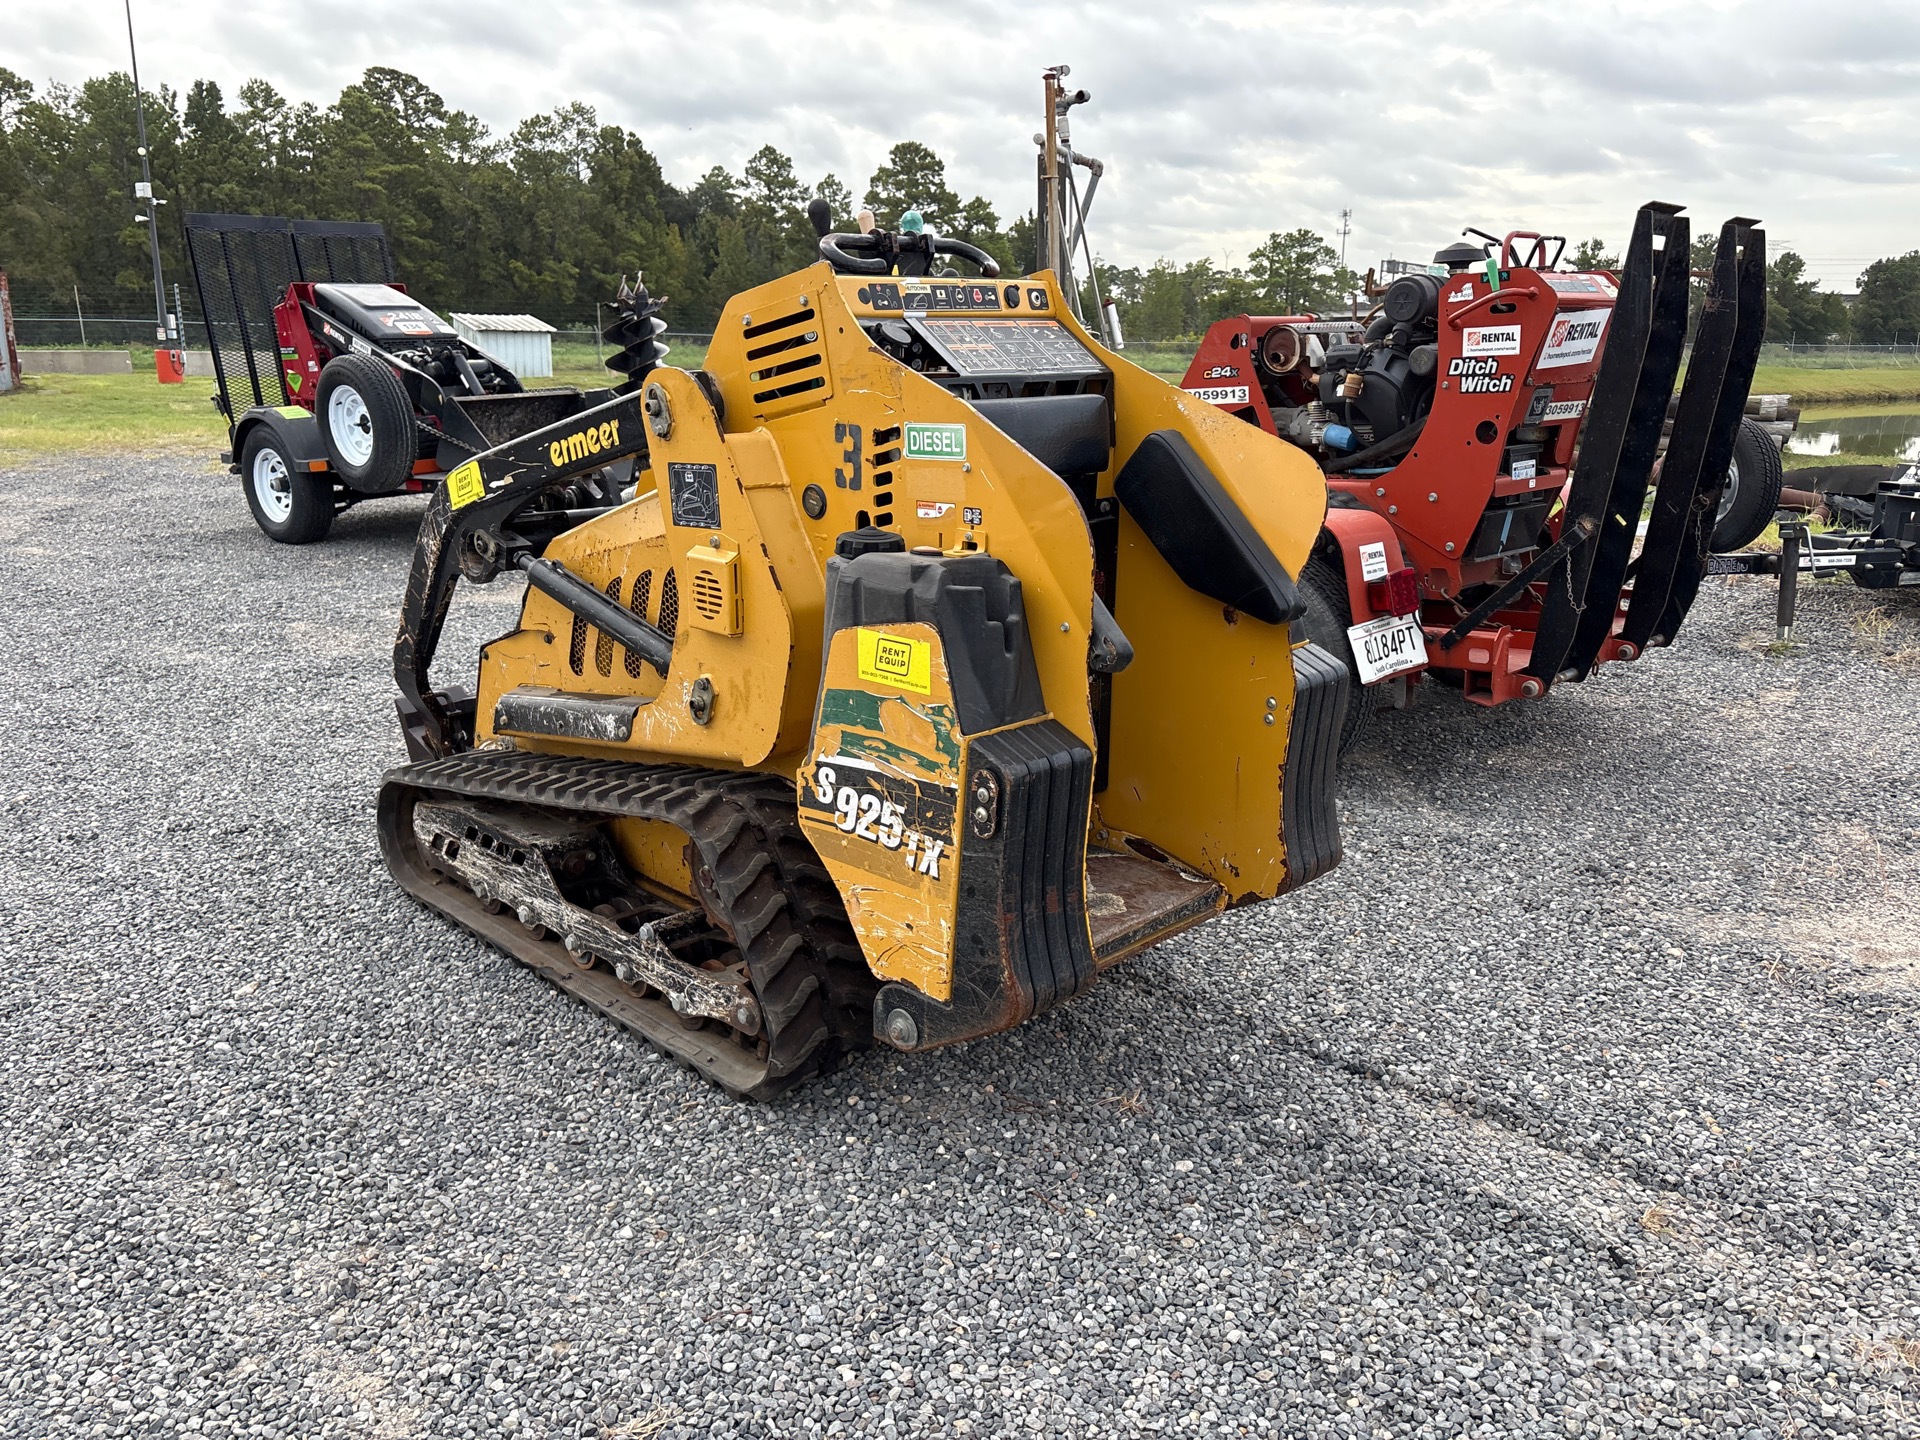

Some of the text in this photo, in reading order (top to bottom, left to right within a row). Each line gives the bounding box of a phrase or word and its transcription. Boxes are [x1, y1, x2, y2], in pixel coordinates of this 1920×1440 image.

[1481, 332, 1517, 343] RENTAL
[1564, 321, 1601, 342] RENTAL
[1448, 358, 1498, 375] Ditch
[1461, 375, 1512, 392] Witch
[1188, 388, 1247, 400] 059913
[1545, 402, 1585, 415] 3059913
[910, 431, 961, 453] DIESEL
[834, 423, 862, 491] 3
[1367, 550, 1384, 560] RENTAL
[881, 646, 906, 658] RENT
[878, 655, 906, 668] EQUIP
